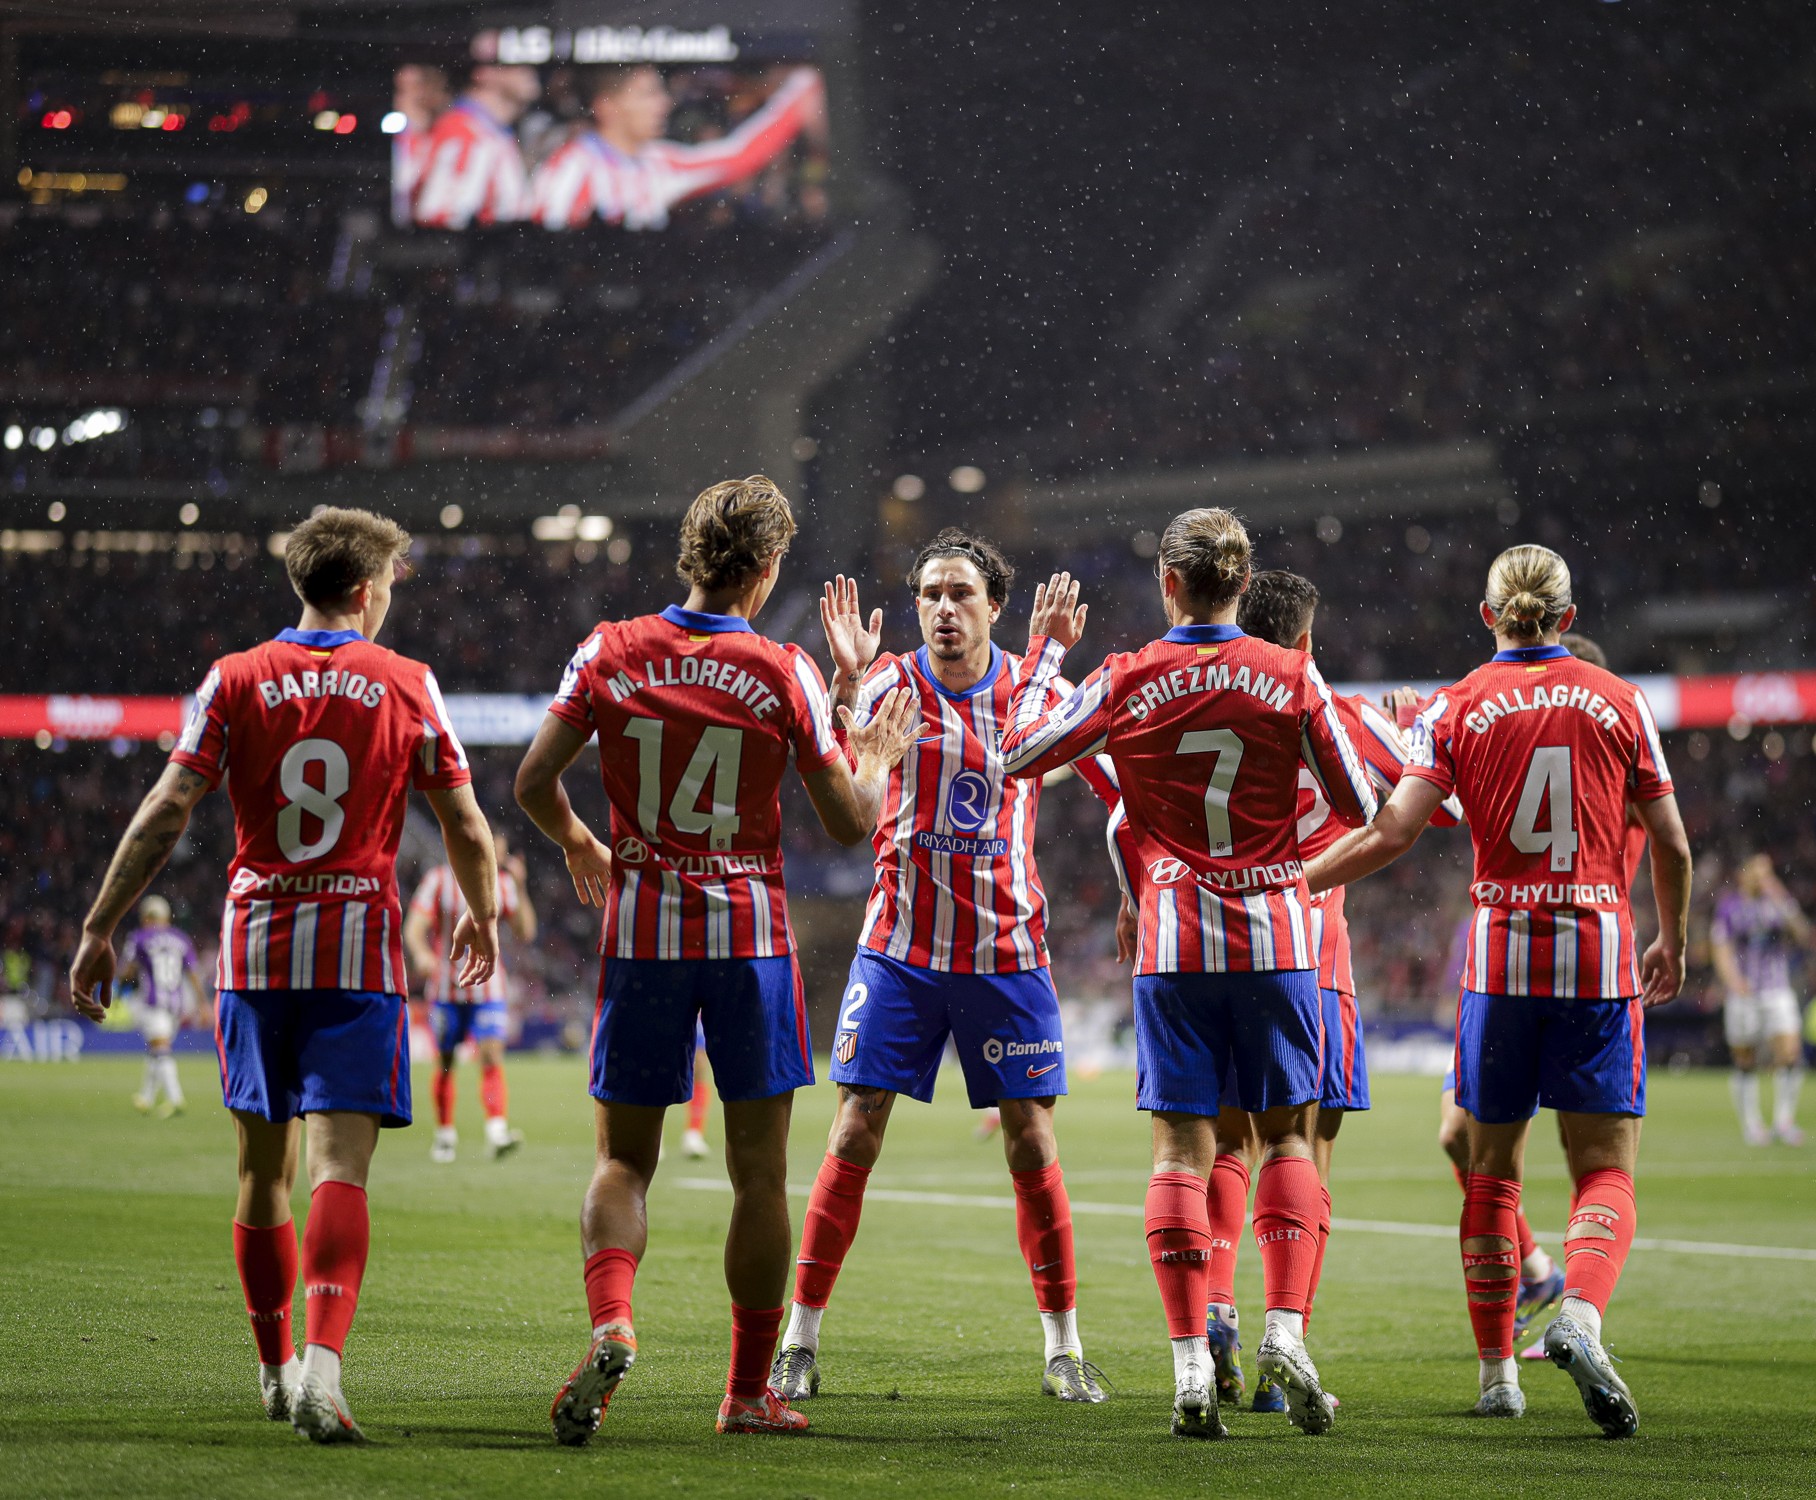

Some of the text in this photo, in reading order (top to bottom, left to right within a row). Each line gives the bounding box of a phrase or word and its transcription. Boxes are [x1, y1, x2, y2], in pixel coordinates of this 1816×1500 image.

[258, 670, 386, 709] BARRIOS
[607, 656, 781, 720] M. LLORENTE
[1126, 664, 1293, 720] GRIEZMANN
[1465, 684, 1620, 734] GALLAGHER
[277, 738, 349, 863] 8
[622, 716, 744, 851] 14
[1175, 728, 1245, 858] 7
[1509, 746, 1578, 872] 4
[919, 832, 1004, 854] RIYADH AIR
[257, 873, 380, 895] HYUNDAI
[1510, 884, 1619, 904] HYUNDAI
[842, 982, 868, 1029] 2
[1007, 1039, 1063, 1056] ComAve
[1161, 1249, 1211, 1262] ATLETI
[1258, 1229, 1300, 1248] ATLETI
